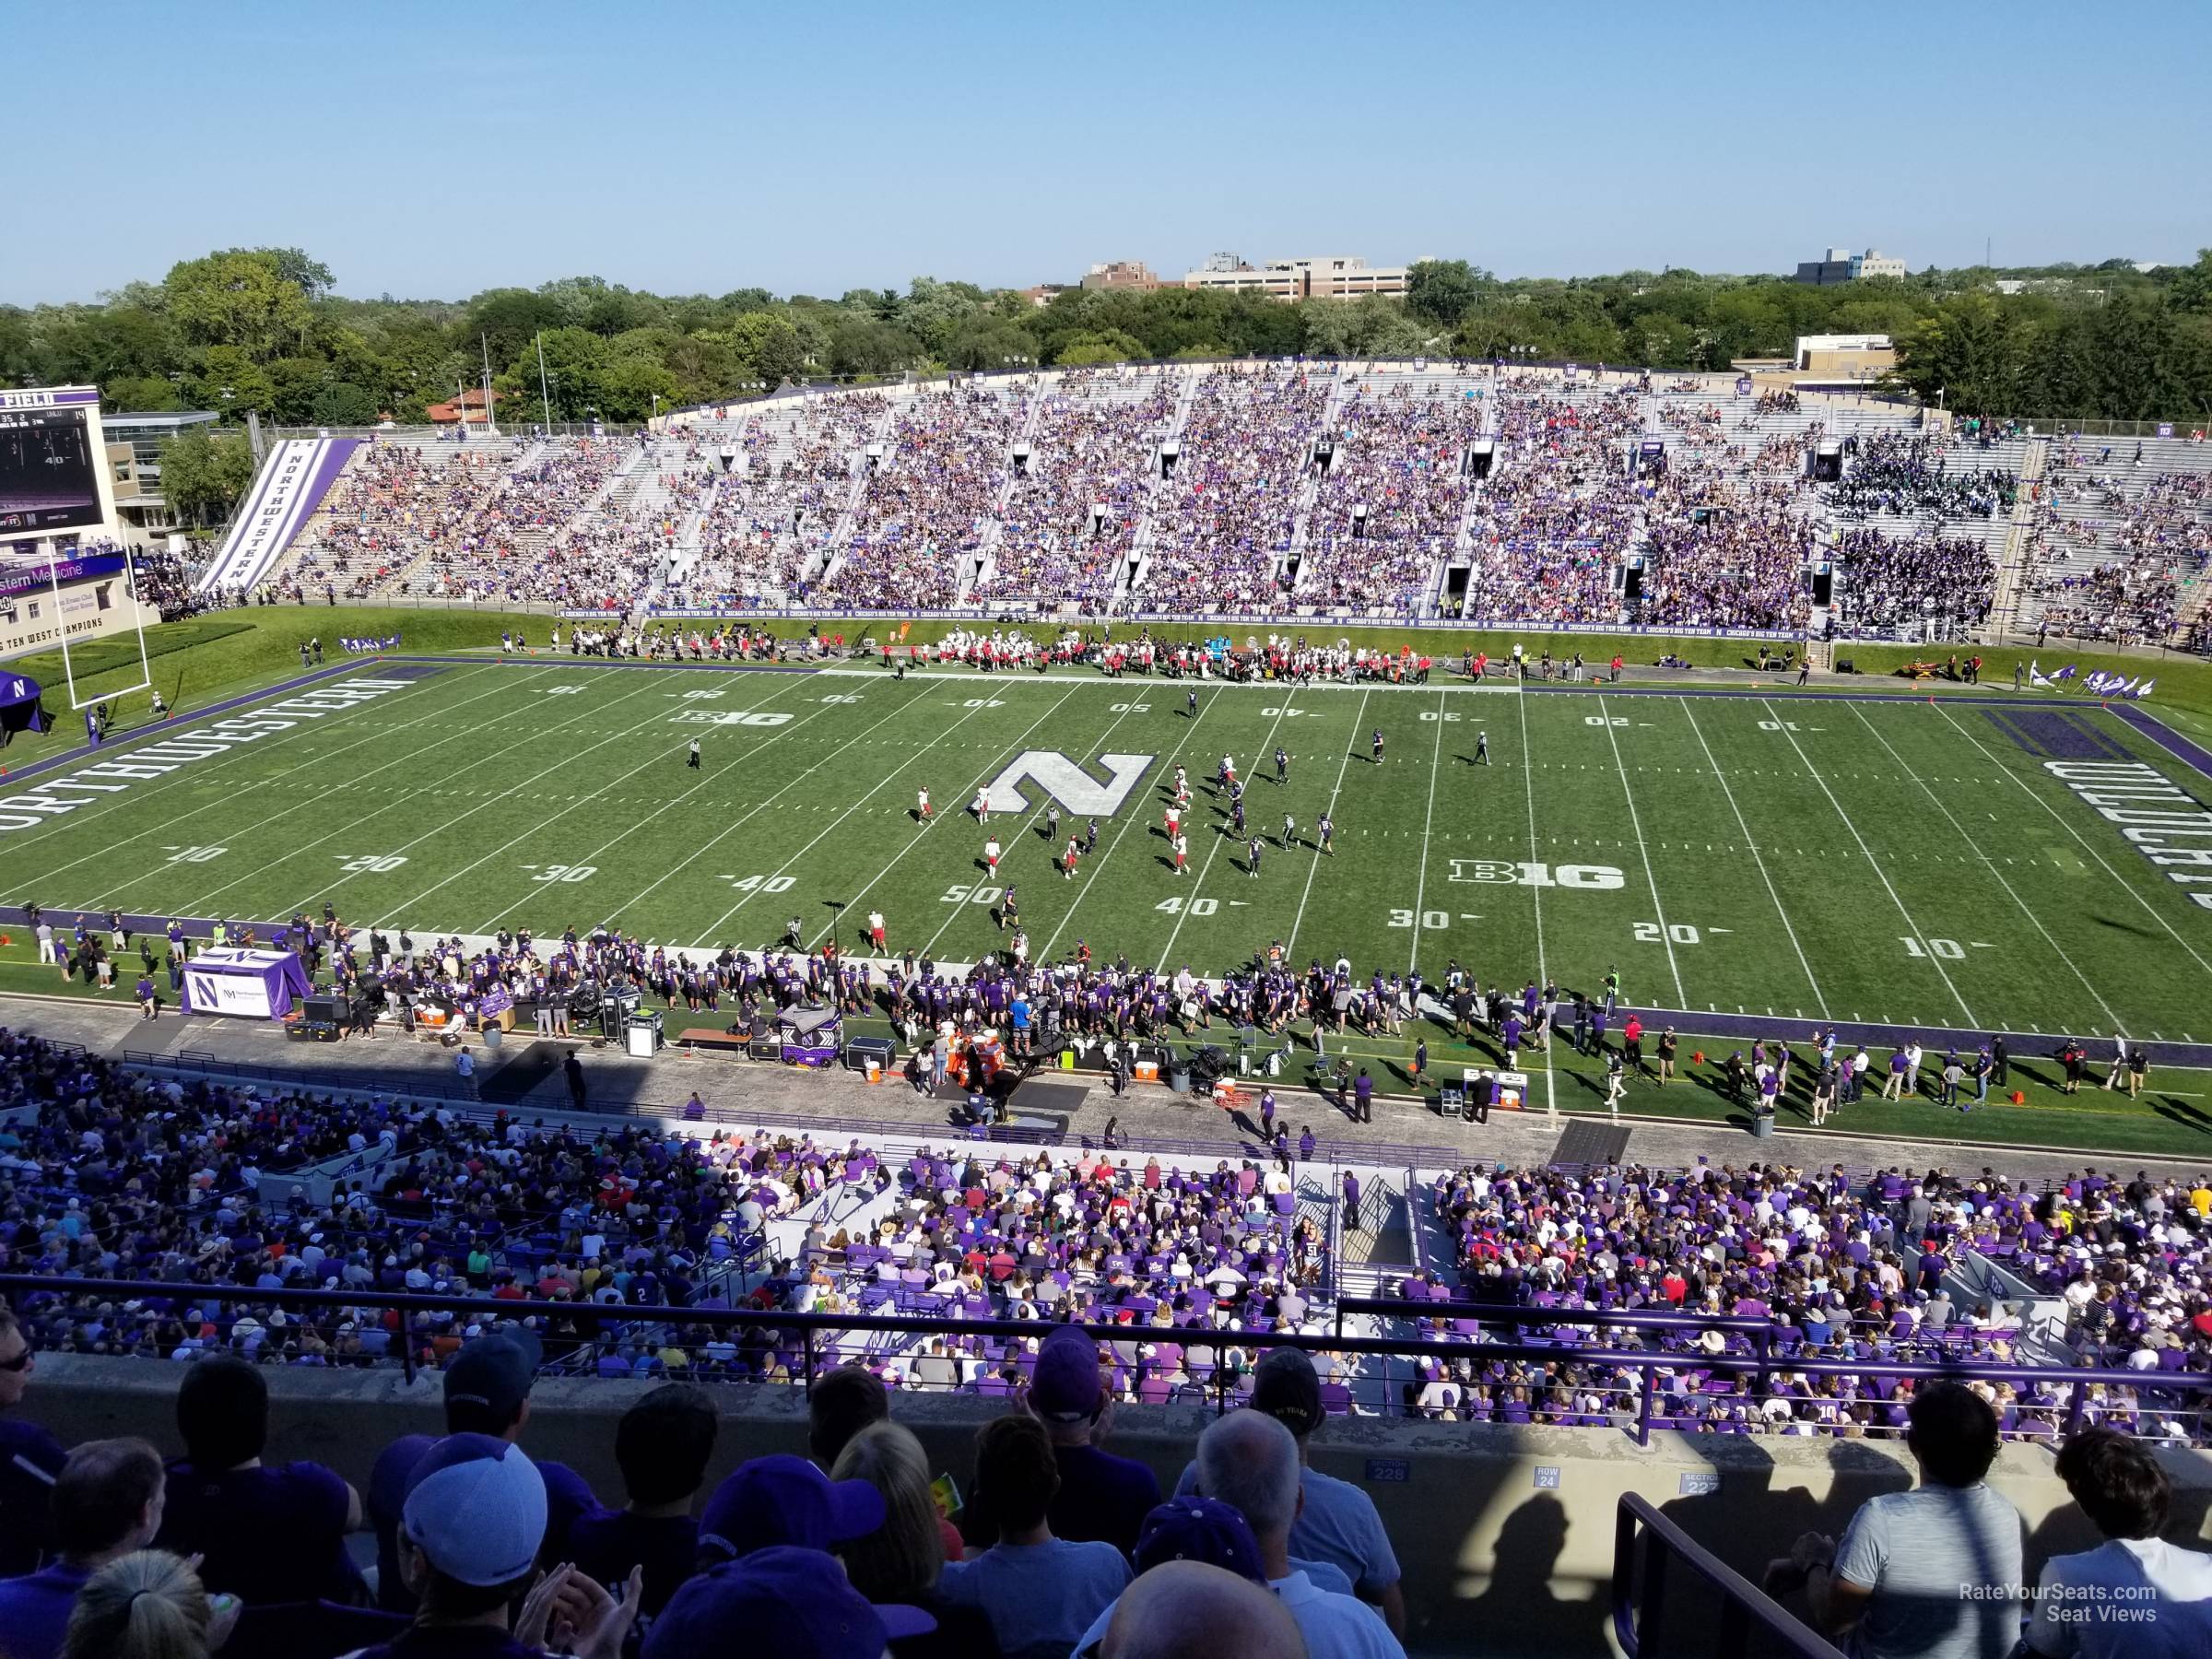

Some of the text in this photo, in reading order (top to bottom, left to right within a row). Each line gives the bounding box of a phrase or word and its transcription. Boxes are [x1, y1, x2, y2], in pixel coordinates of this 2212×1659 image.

[4, 391, 55, 408] FIELD
[74, 411, 85, 420] 14
[229, 455, 303, 578] NORTHWESTERN
[7, 637, 24, 649] TEN
[28, 630, 51, 644] WEST
[14, 679, 25, 697] N
[547, 686, 588, 694] 10
[820, 695, 865, 703] 30
[963, 699, 1006, 708] 40
[1109, 703, 1151, 713] 50
[1261, 707, 1305, 717] 40
[1419, 711, 1462, 722] 30
[1584, 716, 1629, 727] 20
[1757, 720, 1801, 732] 10
[971, 751, 1154, 816] N
[2043, 762, 2212, 911] WILDCA
[165, 846, 228, 862] 10
[339, 856, 408, 872] 20
[531, 865, 598, 882] 30
[731, 875, 797, 893] 40
[939, 885, 1002, 903] 50
[1155, 896, 1219, 916] 40
[1388, 908, 1450, 930] 30
[1632, 922, 1699, 944] 20
[1898, 937, 1966, 959] 10
[195, 976, 218, 1008] N
[1307, 1246, 1317, 1257] 51
[638, 1288, 647, 1302] 2
[1819, 1405, 1836, 1418] 10
[1375, 1468, 1404, 1480] 228
[1540, 1476, 1553, 1487] 24
[1688, 1481, 1719, 1494] 227
